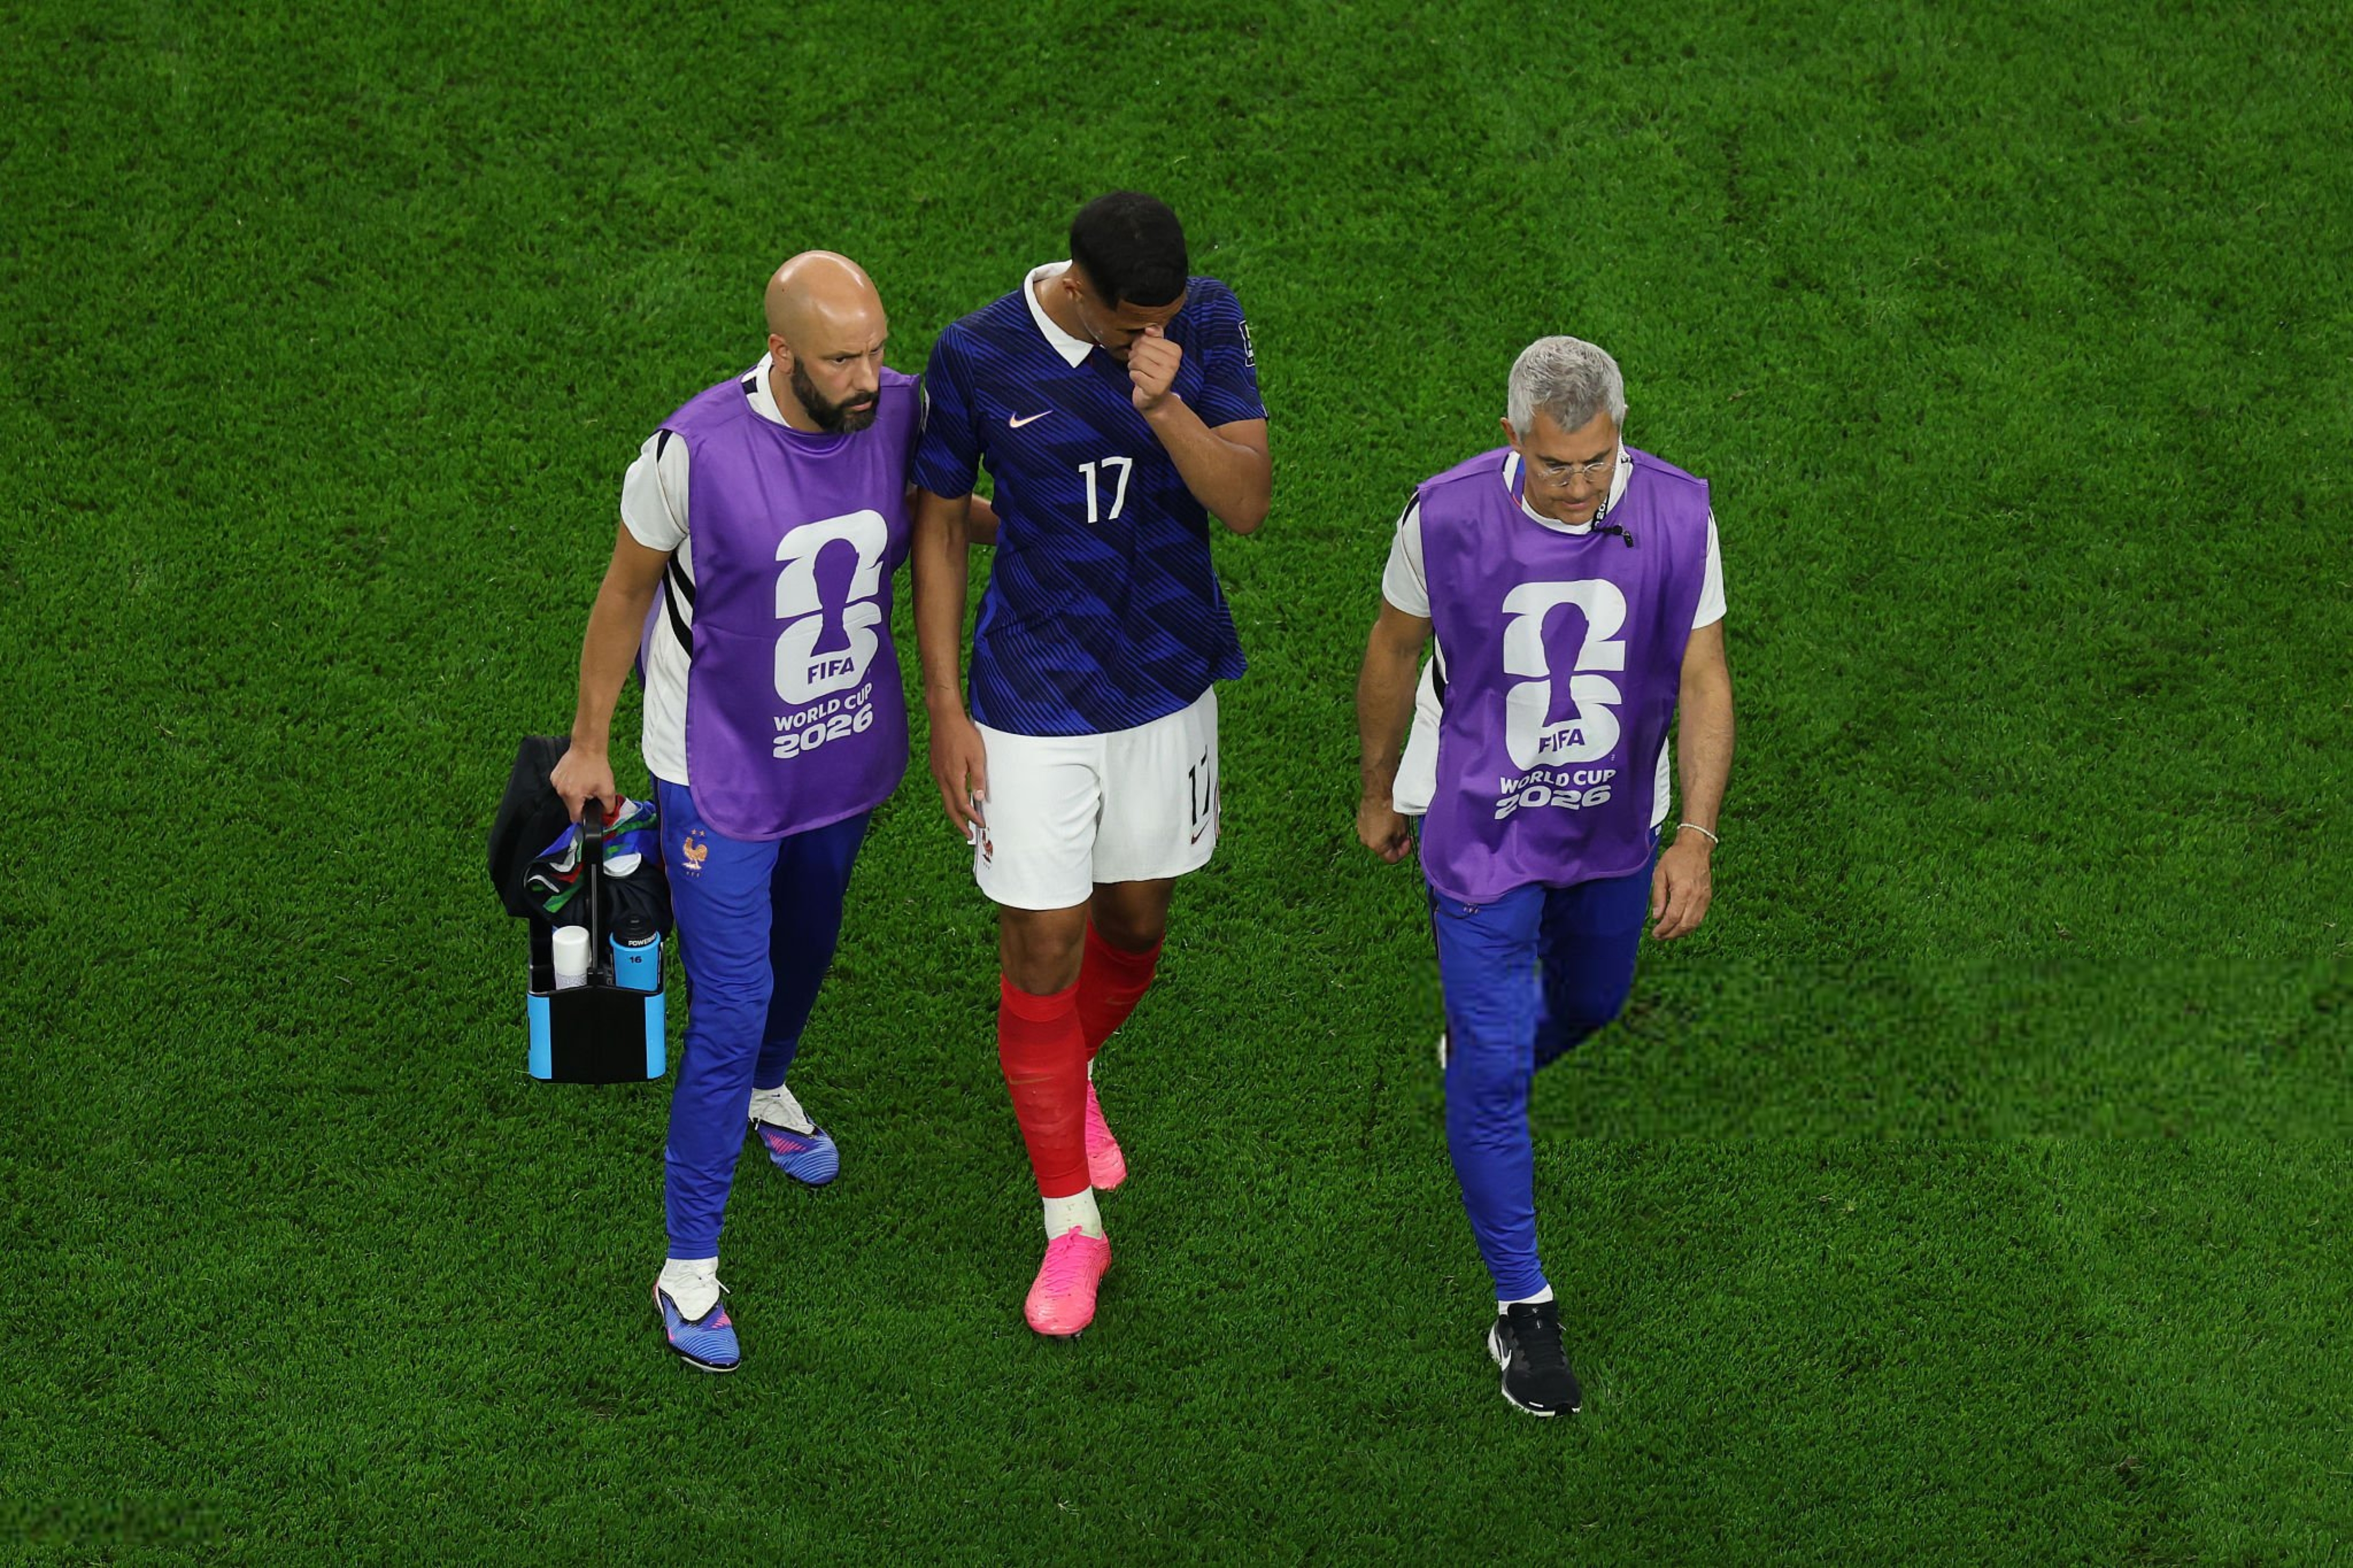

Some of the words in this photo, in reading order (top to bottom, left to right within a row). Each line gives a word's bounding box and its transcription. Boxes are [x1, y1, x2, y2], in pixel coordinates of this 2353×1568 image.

[1079, 456, 1133, 523] 17
[807, 656, 855, 685] FIFA
[773, 698, 840, 731] WORLD
[844, 682, 872, 709] CUP
[773, 703, 873, 758] 2026
[1538, 728, 1585, 754] FIFA
[1500, 770, 1569, 794] WORLD
[1573, 769, 1616, 785] CUP
[1494, 785, 1611, 819] 2026
[629, 956, 643, 964] 16
